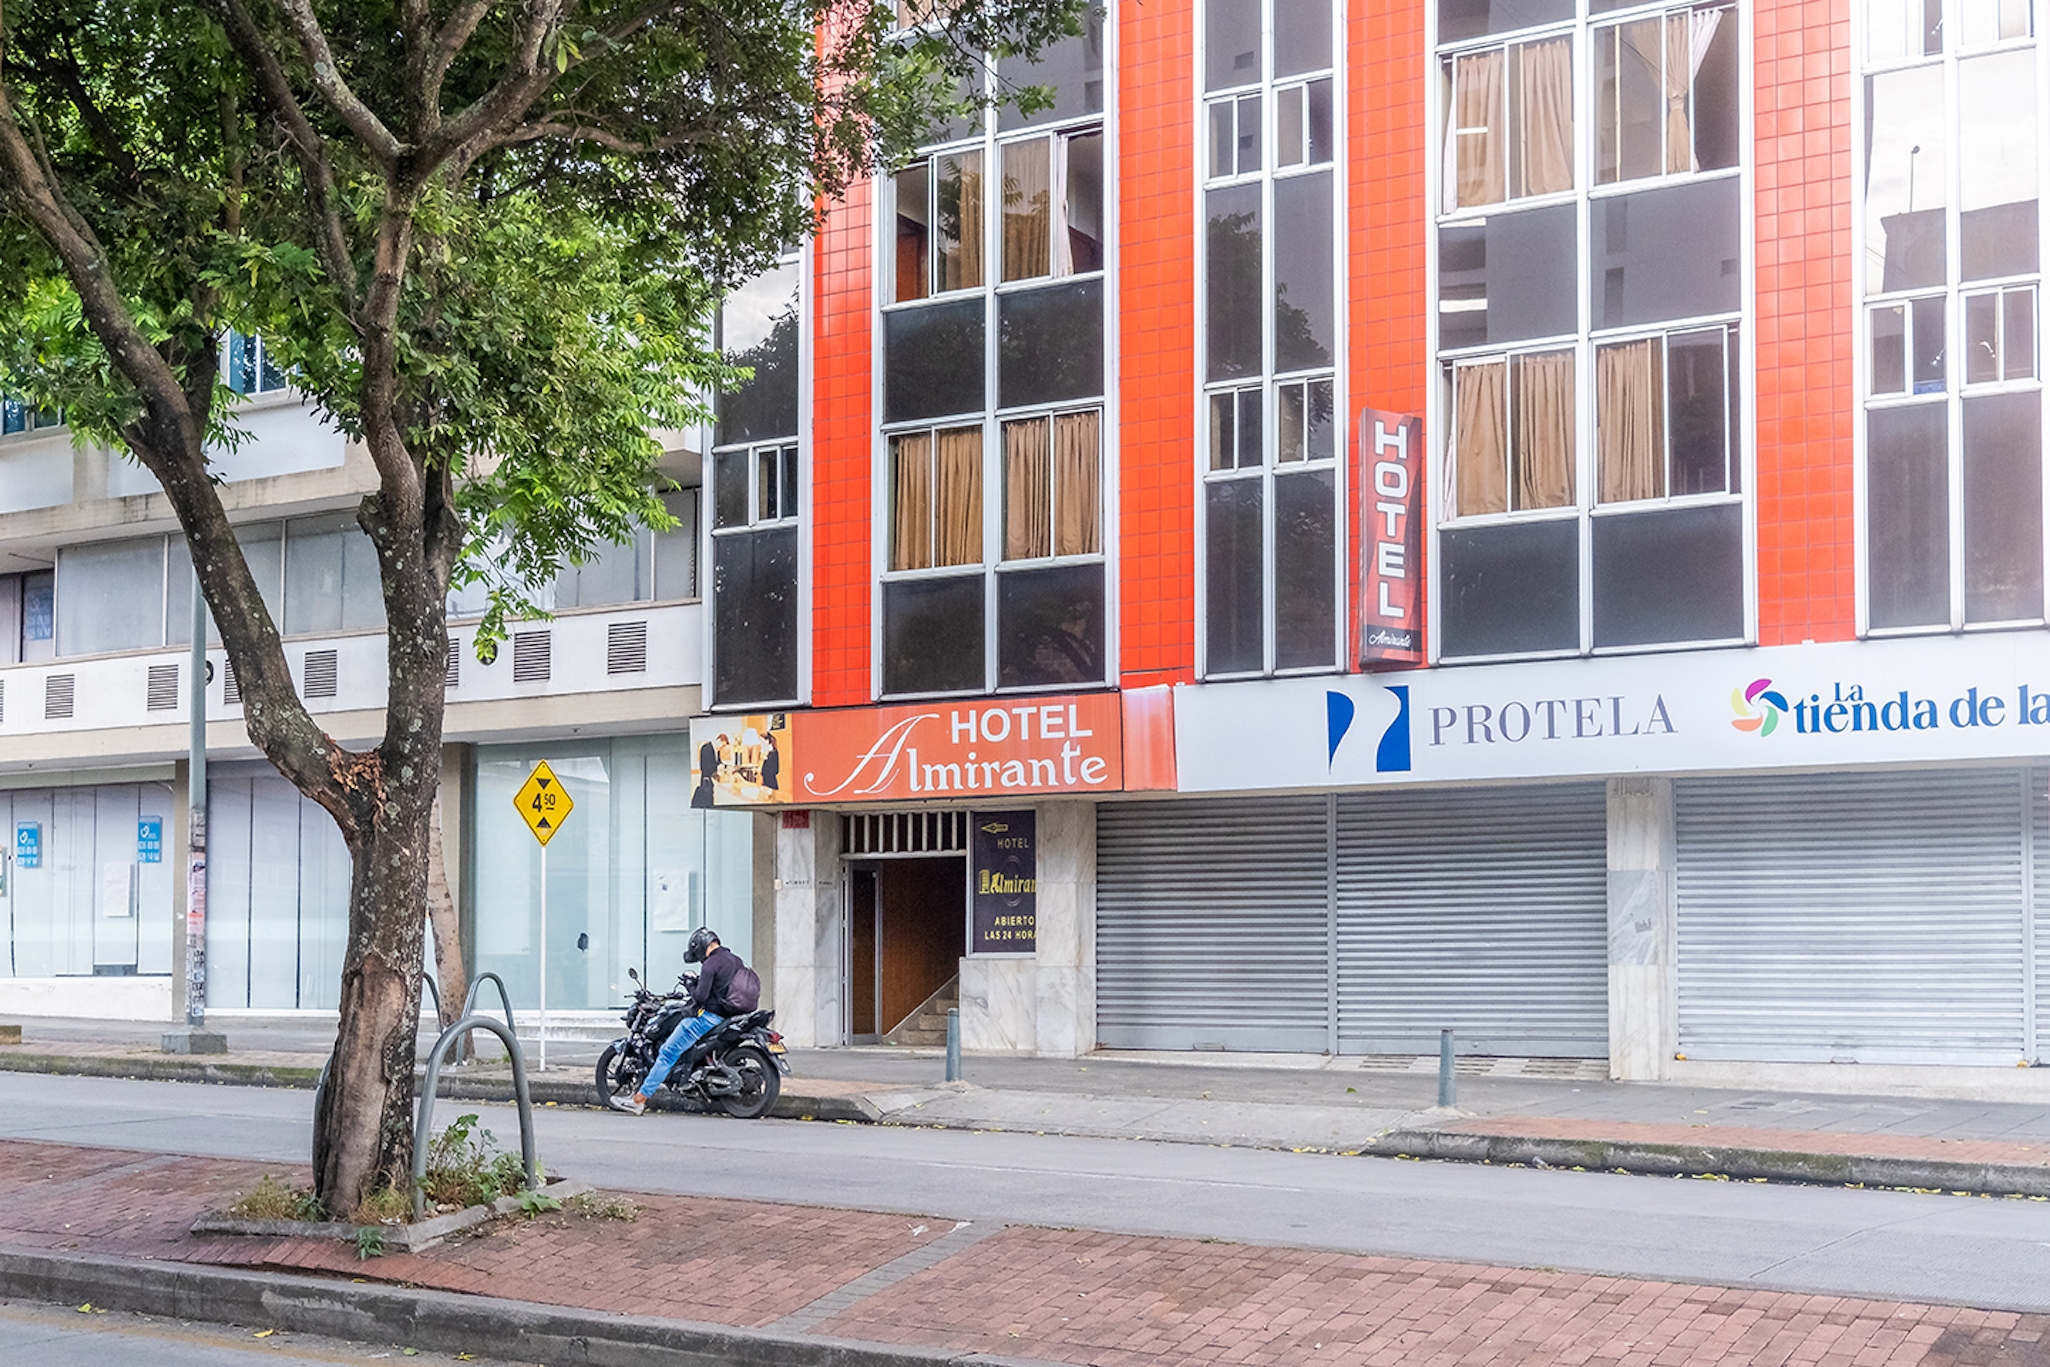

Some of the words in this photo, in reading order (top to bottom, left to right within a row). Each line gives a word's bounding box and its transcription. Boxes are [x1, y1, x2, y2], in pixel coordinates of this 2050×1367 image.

[1374, 420, 1408, 618] HOTEL
[1793, 690, 1939, 734] tienda
[1949, 686, 2006, 728] de
[2017, 684, 2050, 725] la
[1834, 682, 1863, 702] La
[951, 704, 1093, 744] HOTEL
[1428, 693, 1679, 746] PROTELA
[803, 713, 1109, 797] Almirante
[997, 837, 1029, 849] HOTEL
[984, 930, 1001, 941] LAS
[1002, 930, 1012, 940] 24
[994, 915, 1035, 927] ABIERTO
